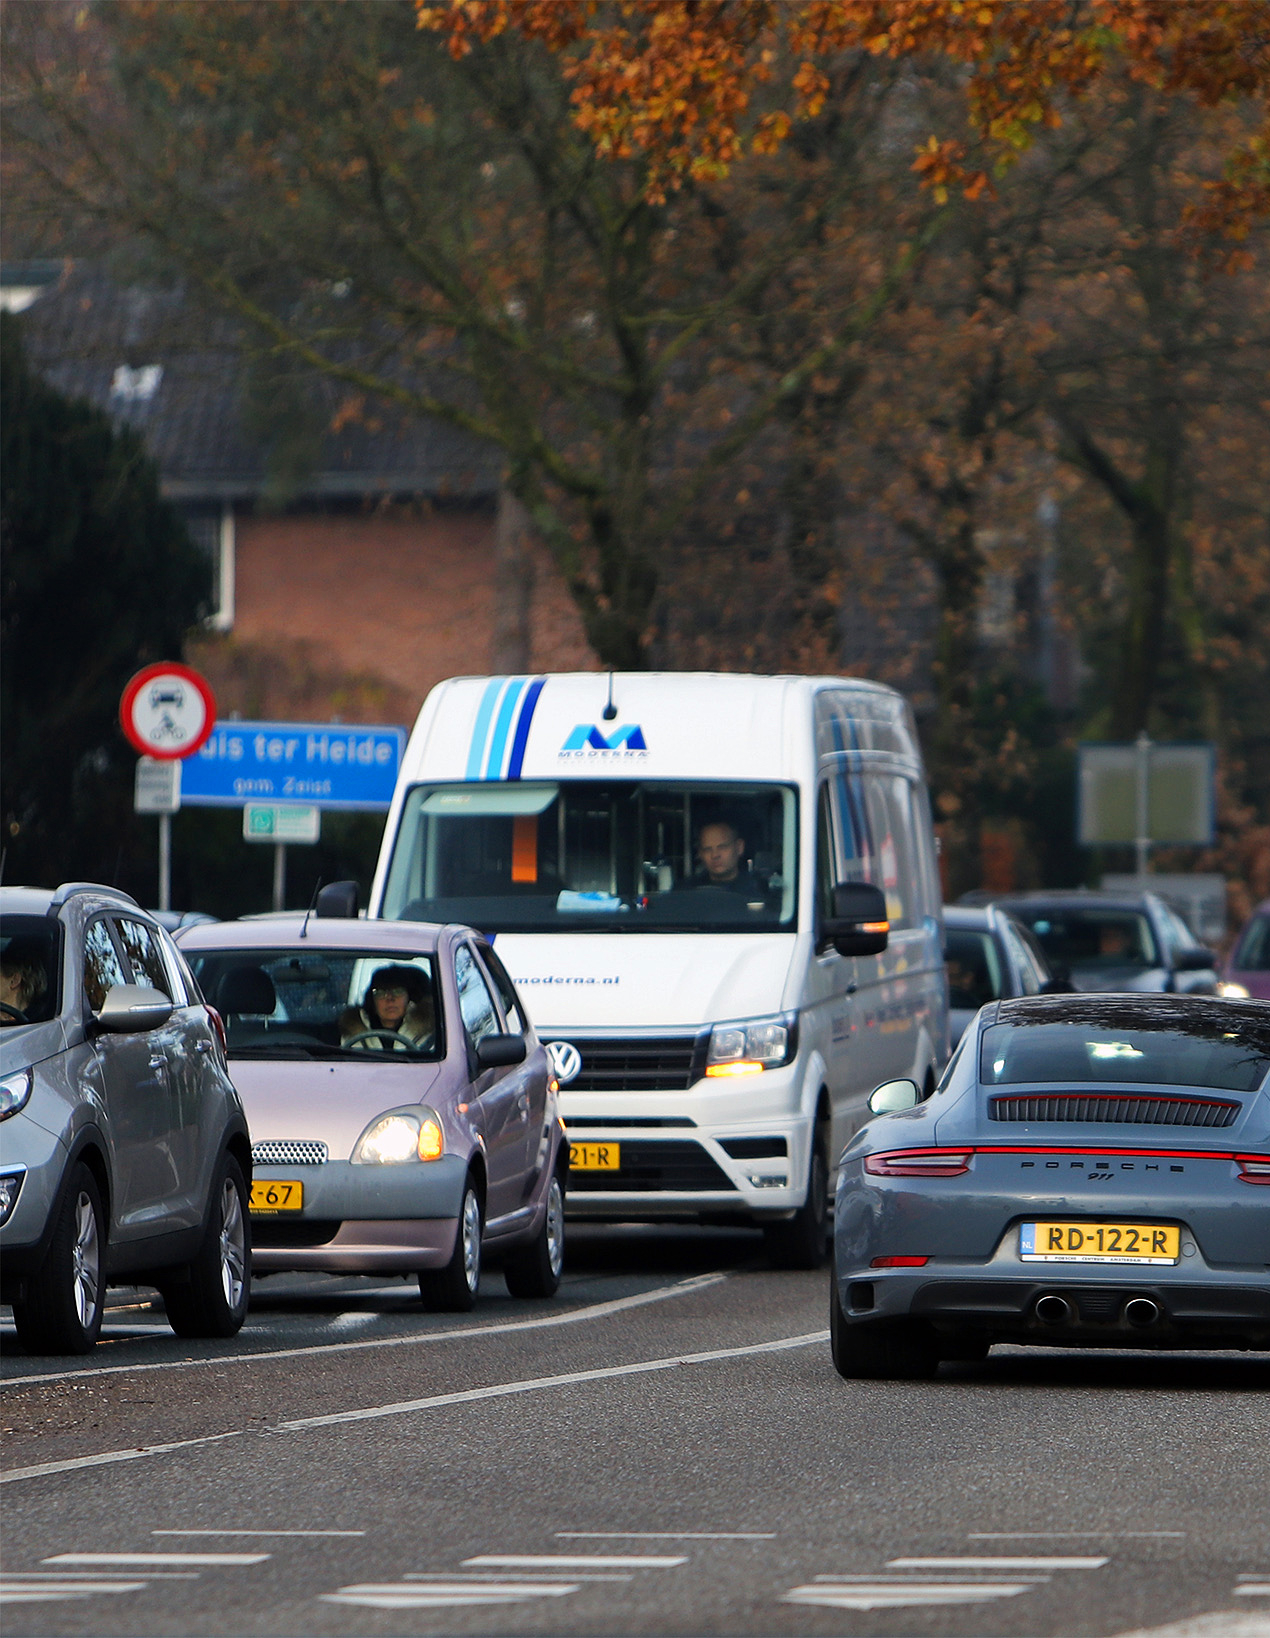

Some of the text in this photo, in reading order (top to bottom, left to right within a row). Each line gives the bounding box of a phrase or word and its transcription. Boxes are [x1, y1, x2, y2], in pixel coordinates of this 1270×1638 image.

[200, 732, 393, 764] uis ter Heide
[557, 750, 649, 758] MODERNA
[282, 776, 332, 794] Zeist
[513, 975, 620, 985] moderna.nl
[1021, 1162, 1184, 1173] PORSCHE
[1088, 1173, 1114, 1181] 911
[1022, 1241, 1033, 1250] NL
[1048, 1227, 1167, 1254] RD-122-R
